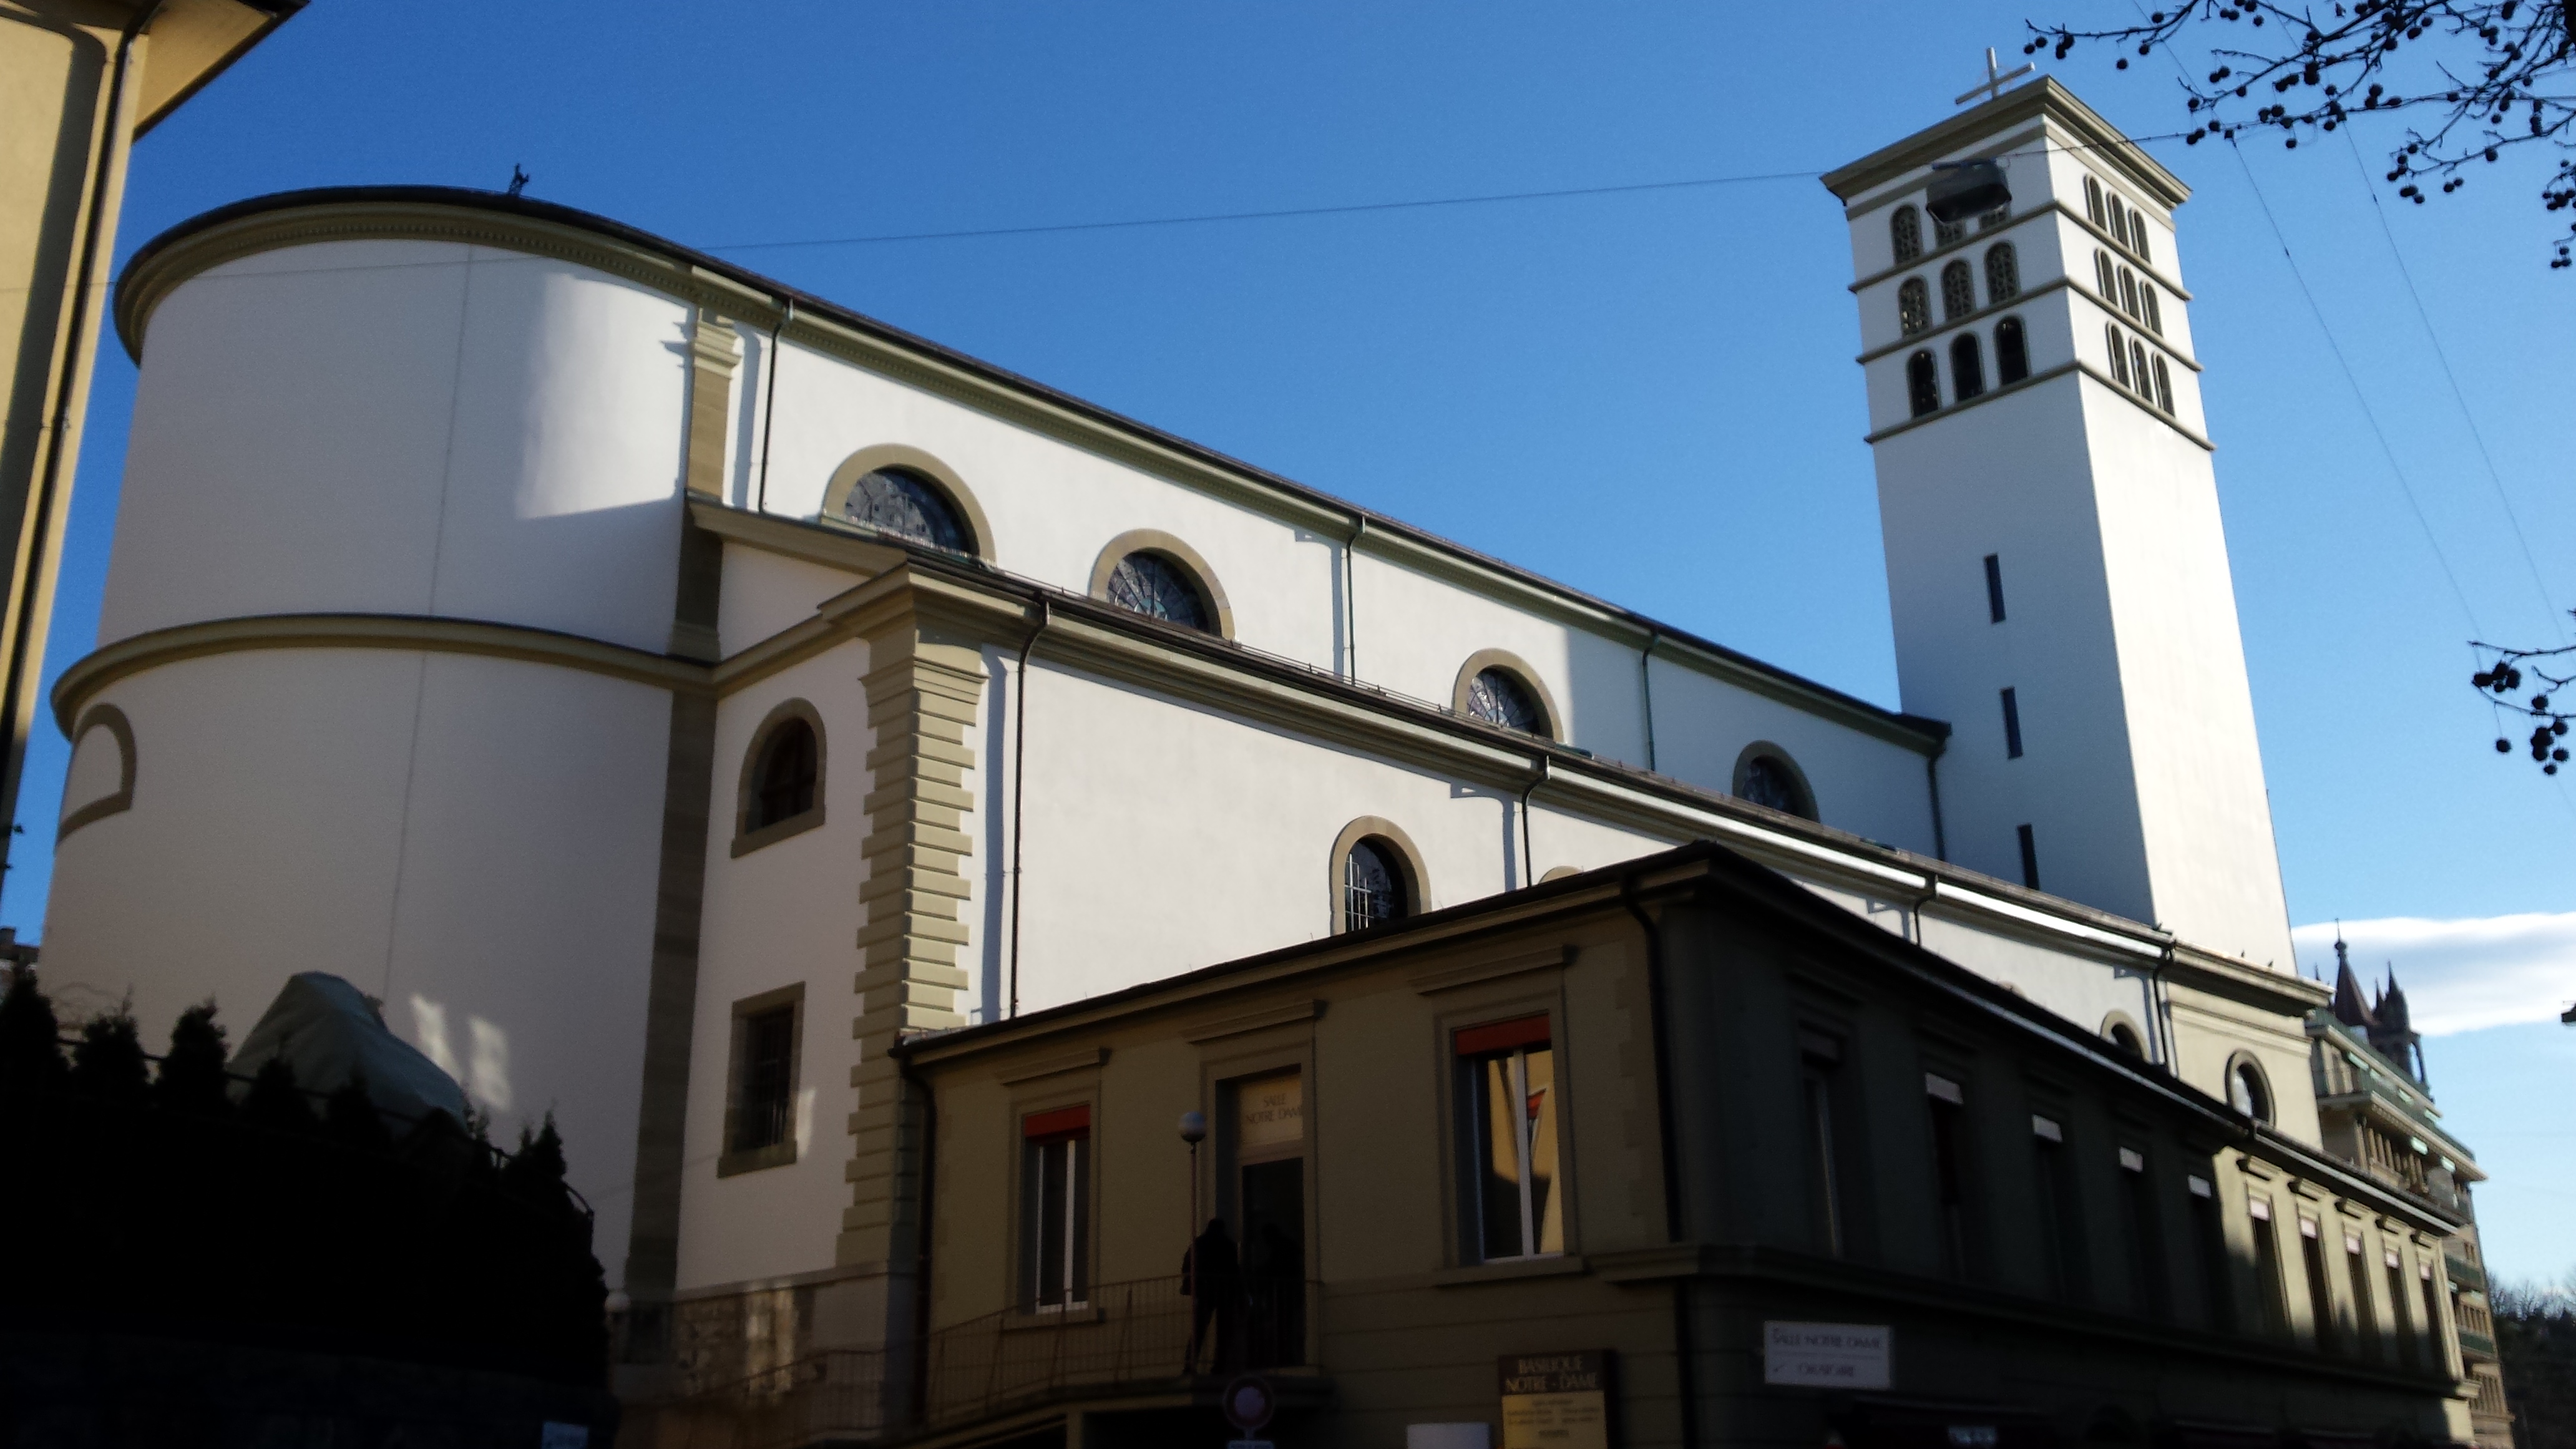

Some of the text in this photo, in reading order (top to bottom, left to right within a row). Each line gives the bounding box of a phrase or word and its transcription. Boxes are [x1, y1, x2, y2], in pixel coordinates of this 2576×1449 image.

[1264, 1093, 1286, 1107] SALLE
[1246, 1110, 1274, 1124] NOTRE
[1518, 1355, 1583, 1374] BASILIQUE
[1505, 1375, 1547, 1392] NOTRE
[1560, 1372, 1597, 1389] DAME
